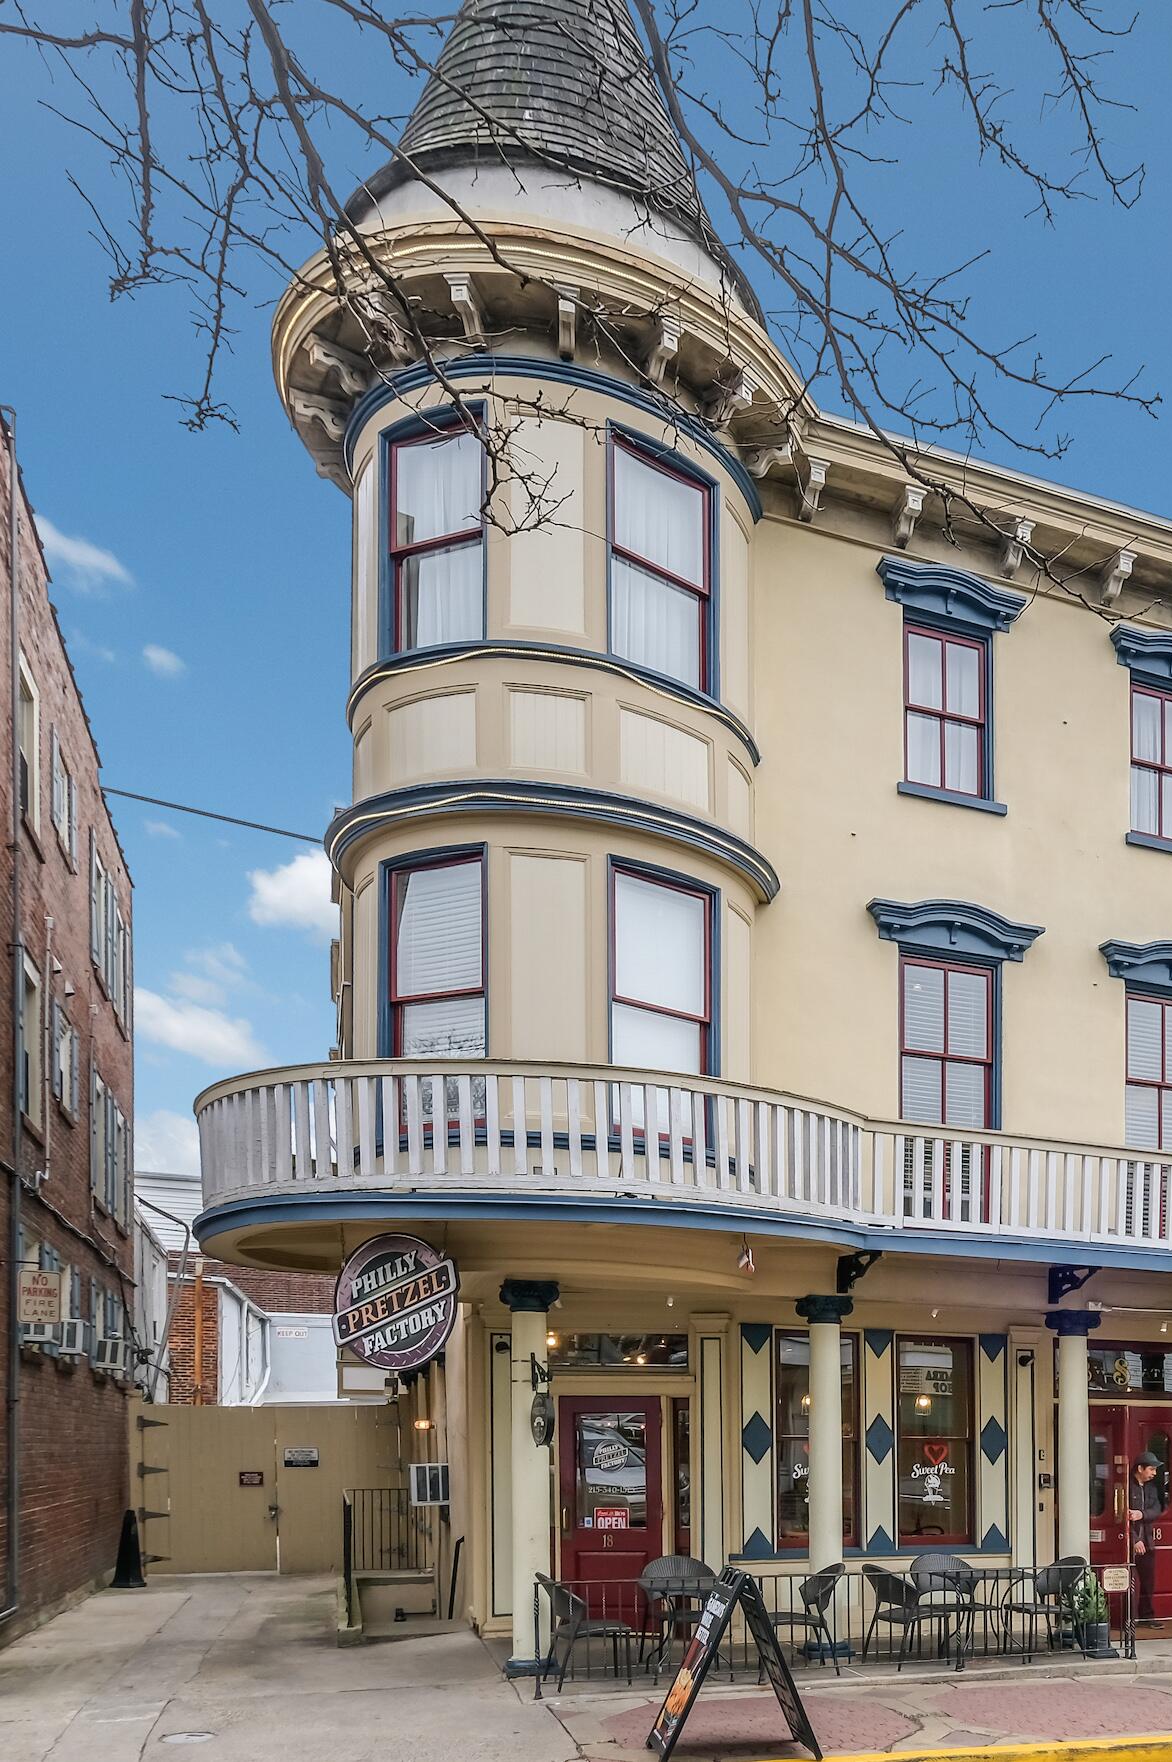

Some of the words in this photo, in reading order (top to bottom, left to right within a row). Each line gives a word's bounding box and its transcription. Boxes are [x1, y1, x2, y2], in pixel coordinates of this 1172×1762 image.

[32, 1276, 48, 1286] NO
[350, 1250, 417, 1299] PHILLY
[22, 1286, 57, 1298] PARKING
[25, 1299, 55, 1308] FIRE
[346, 1270, 445, 1334] PRETZEL
[24, 1310, 56, 1318] LANE
[361, 1300, 447, 1357] FACTORY
[599, 1444, 619, 1455] PHILLY
[600, 1457, 626, 1470] FACTORY
[938, 1462, 956, 1475] Pea
[597, 1516, 626, 1529] OPEN
[1152, 1528, 1162, 1540] 18
[602, 1534, 614, 1548] 18
